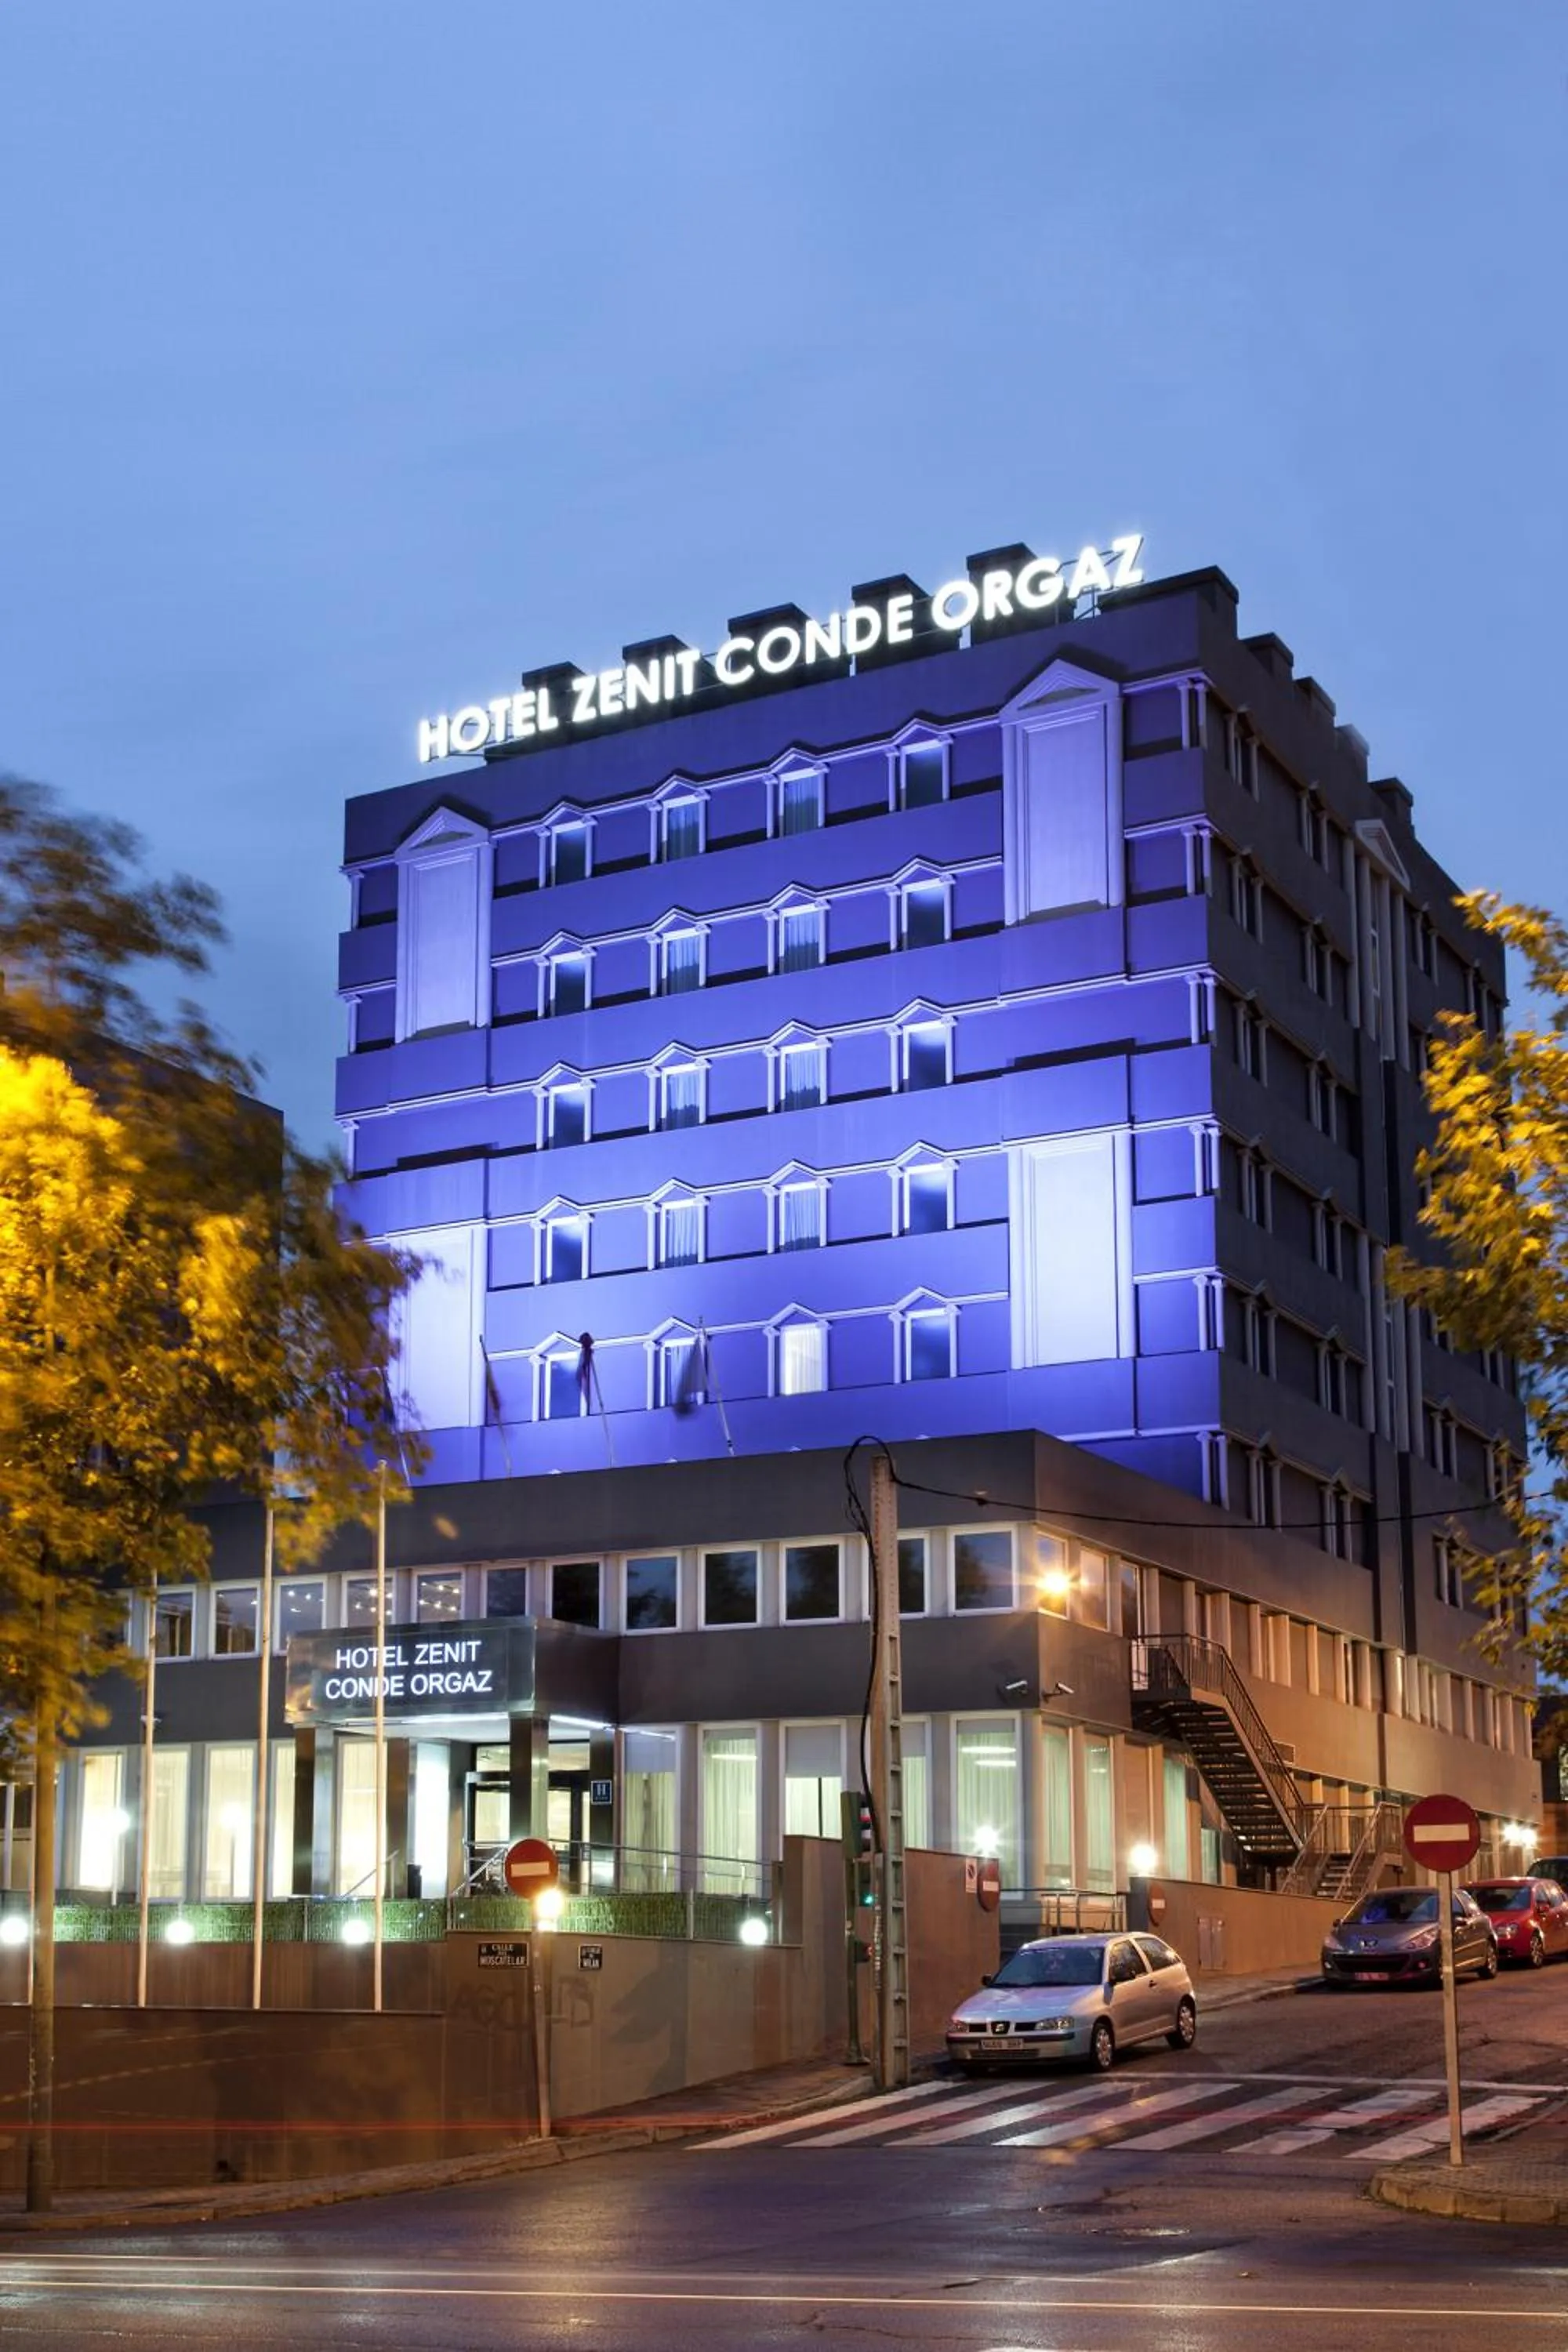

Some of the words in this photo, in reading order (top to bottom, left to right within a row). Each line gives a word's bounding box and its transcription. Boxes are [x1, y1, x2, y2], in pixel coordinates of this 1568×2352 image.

[418, 687, 558, 763] HOTEL
[572, 650, 700, 723] ZENIT
[714, 594, 913, 685] CONDE
[931, 533, 1143, 630] ORGAZ
[336, 1646, 408, 1670] HOTEL
[414, 1640, 482, 1665] ZENIT
[325, 1675, 405, 1700] CONDE
[410, 1670, 493, 1696] ORGAZ
[597, 1784, 606, 1795] H
